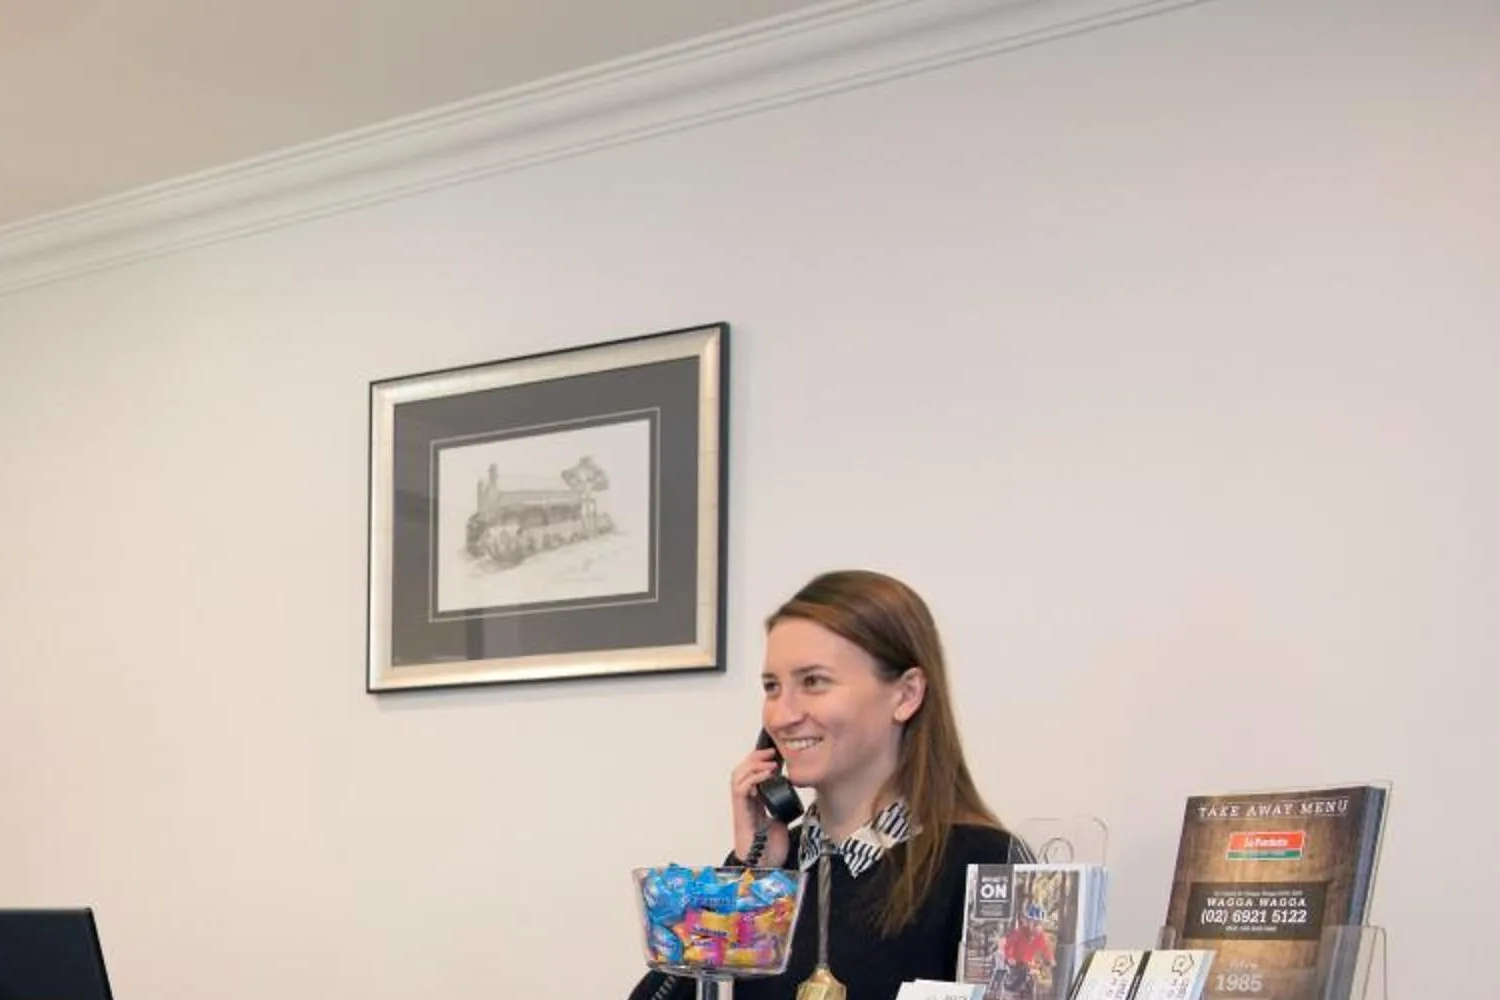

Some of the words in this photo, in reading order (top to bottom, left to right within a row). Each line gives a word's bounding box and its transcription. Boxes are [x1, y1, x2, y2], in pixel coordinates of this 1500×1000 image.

[1197, 804, 1239, 818] TAKE
[1246, 802, 1293, 817] AWAY
[1300, 799, 1348, 815] MENU
[980, 883, 1007, 899] ON
[1207, 897, 1253, 907] WAGGA
[1259, 897, 1307, 907] WAGGA
[1201, 909, 1229, 925] (02)
[1232, 909, 1267, 924] 6921
[1271, 909, 1308, 923] 5122
[1215, 972, 1264, 993] 1985
